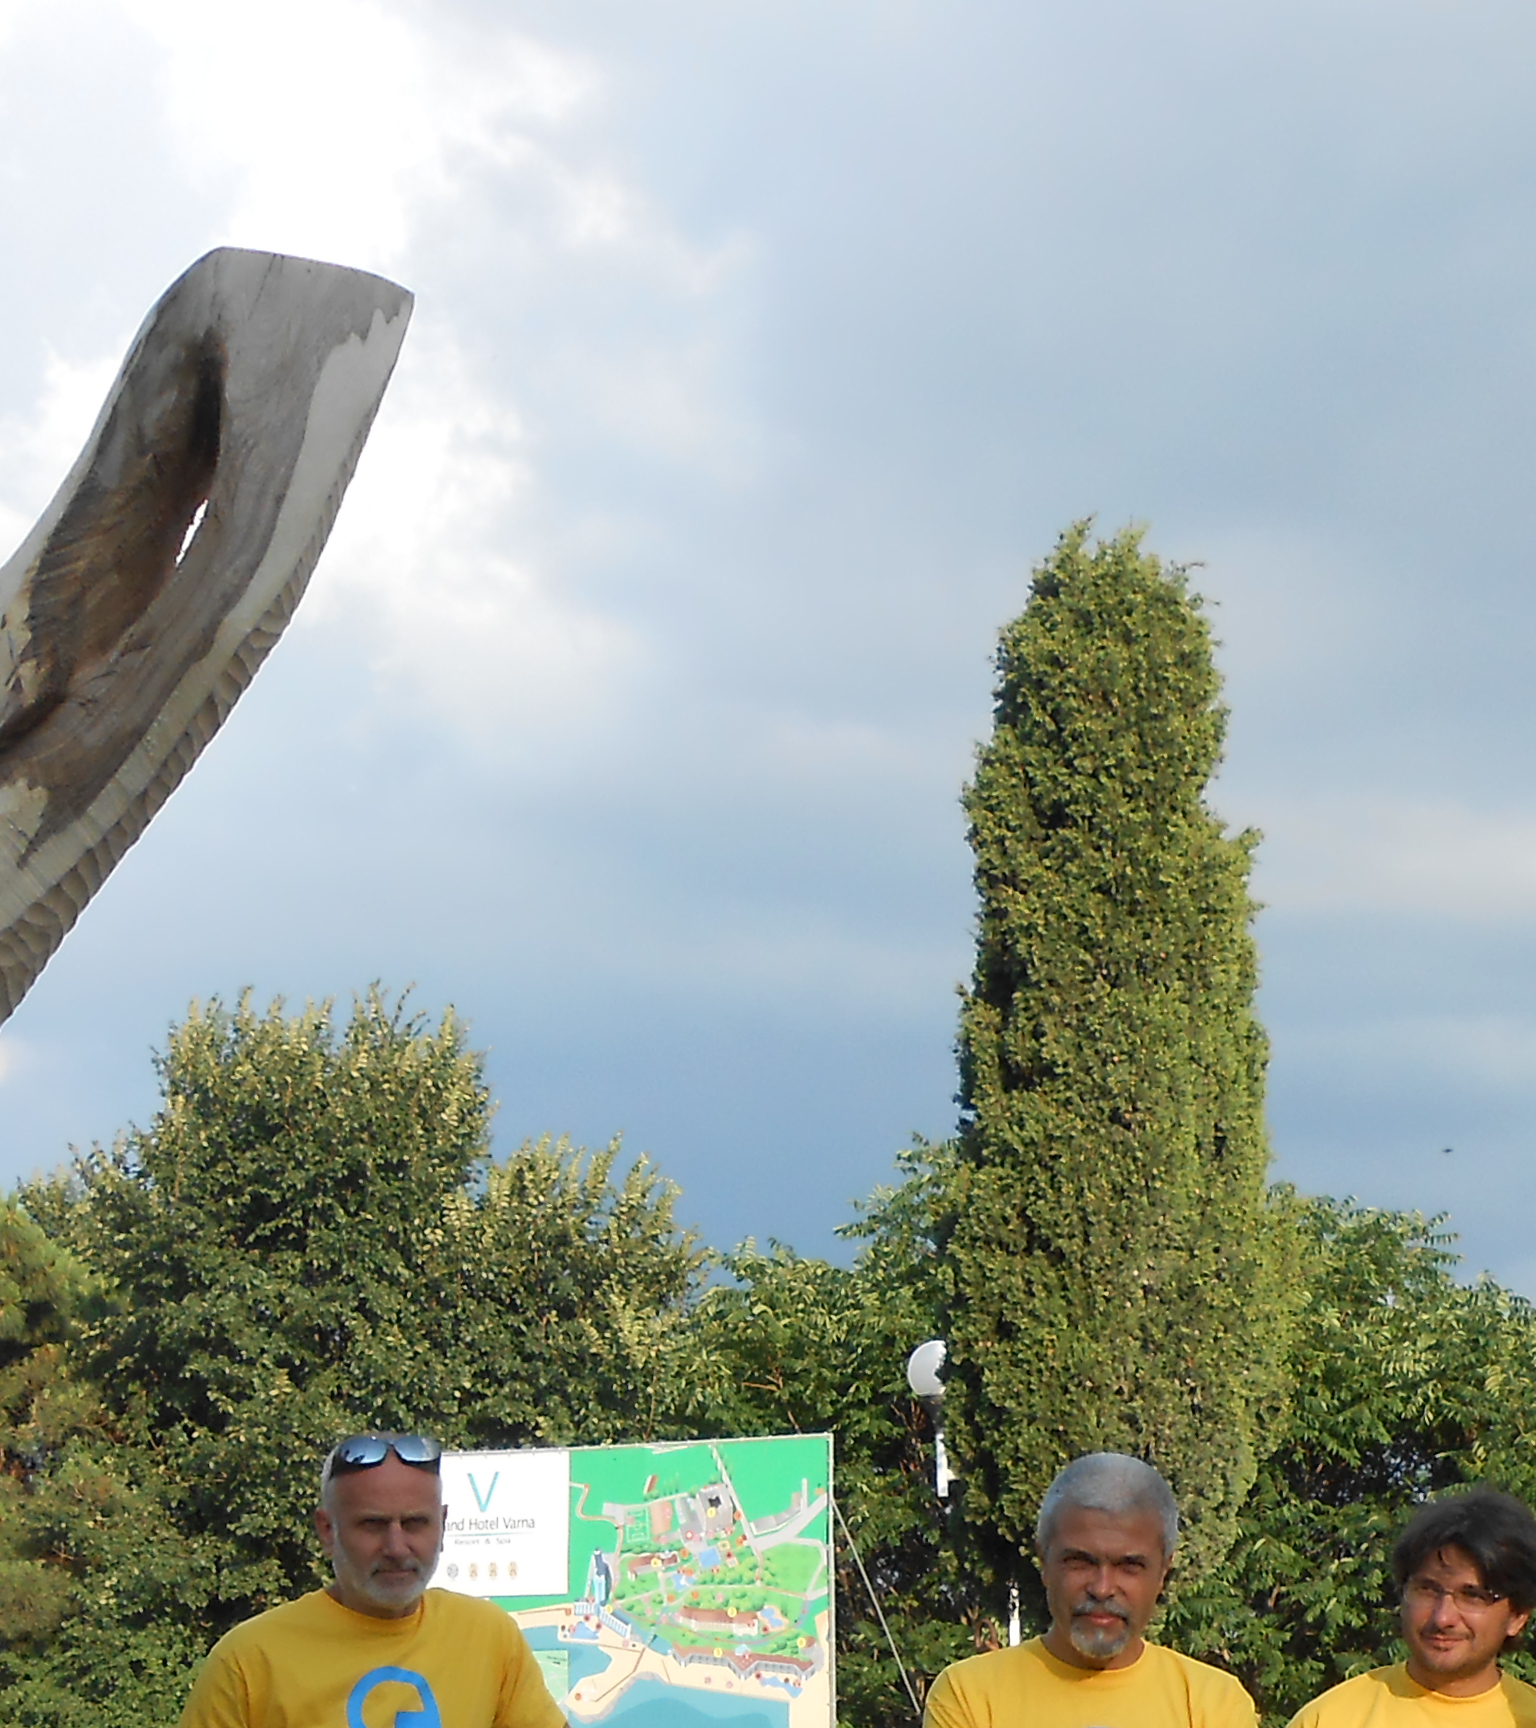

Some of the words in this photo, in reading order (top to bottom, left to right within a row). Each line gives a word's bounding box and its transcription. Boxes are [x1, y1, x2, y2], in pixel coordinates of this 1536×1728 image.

[467, 1471, 500, 1513] V
[468, 1517, 499, 1531] Hotel
[502, 1517, 536, 1530] Varna
